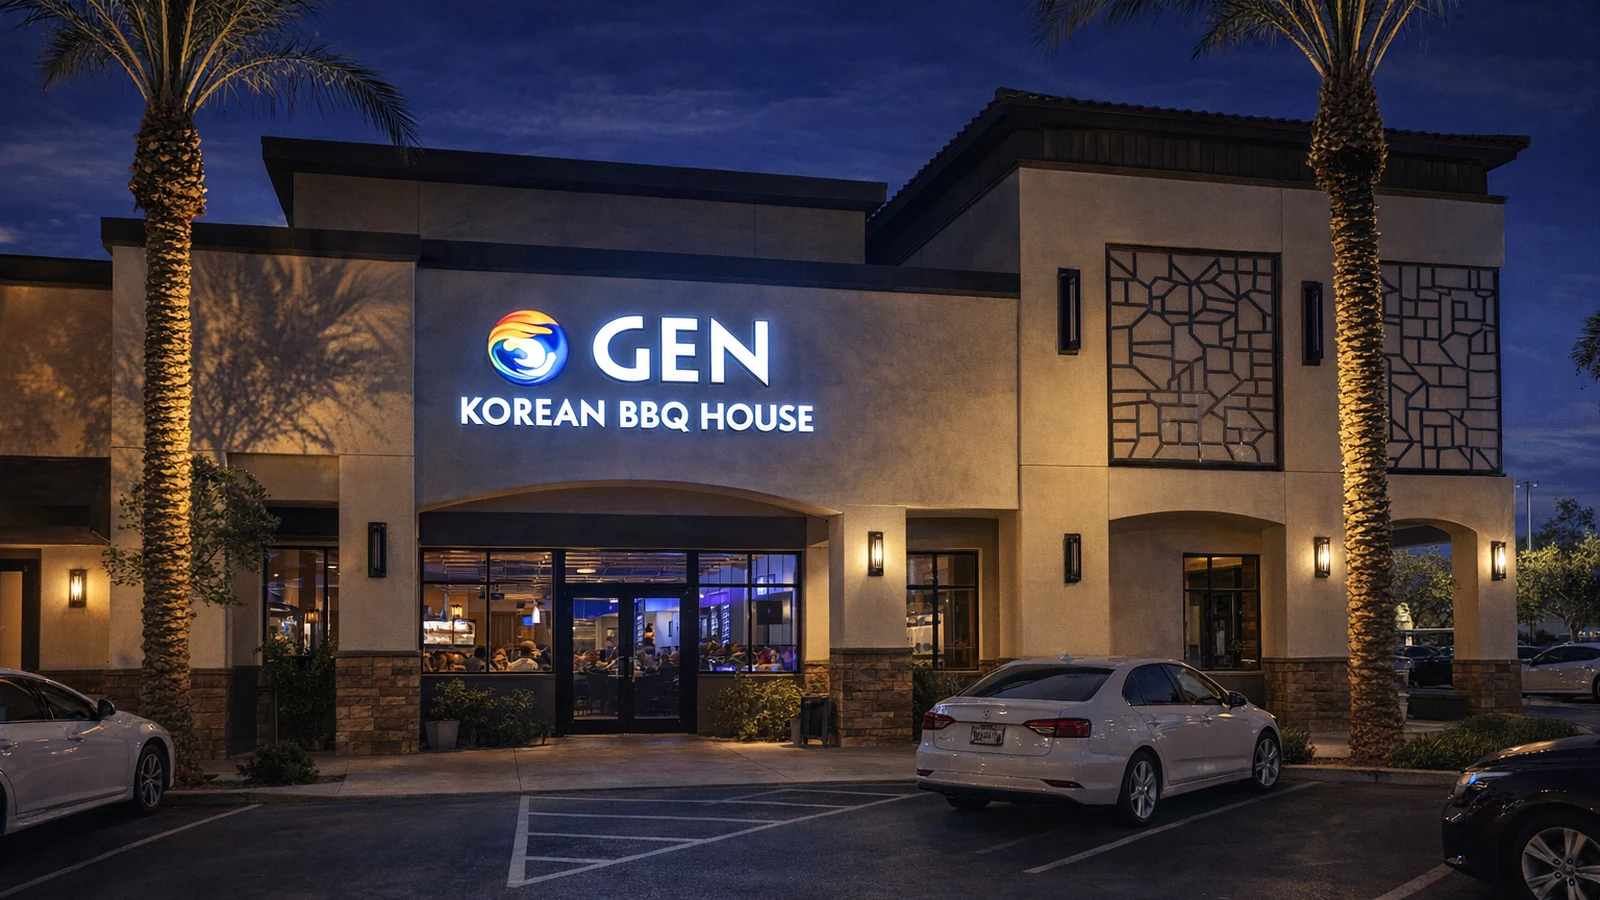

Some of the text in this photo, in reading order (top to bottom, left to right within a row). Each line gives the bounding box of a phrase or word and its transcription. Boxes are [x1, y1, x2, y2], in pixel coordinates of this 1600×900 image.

[593, 316, 769, 386] GEN
[460, 397, 814, 432] KOREAN BBQ HOUSE
